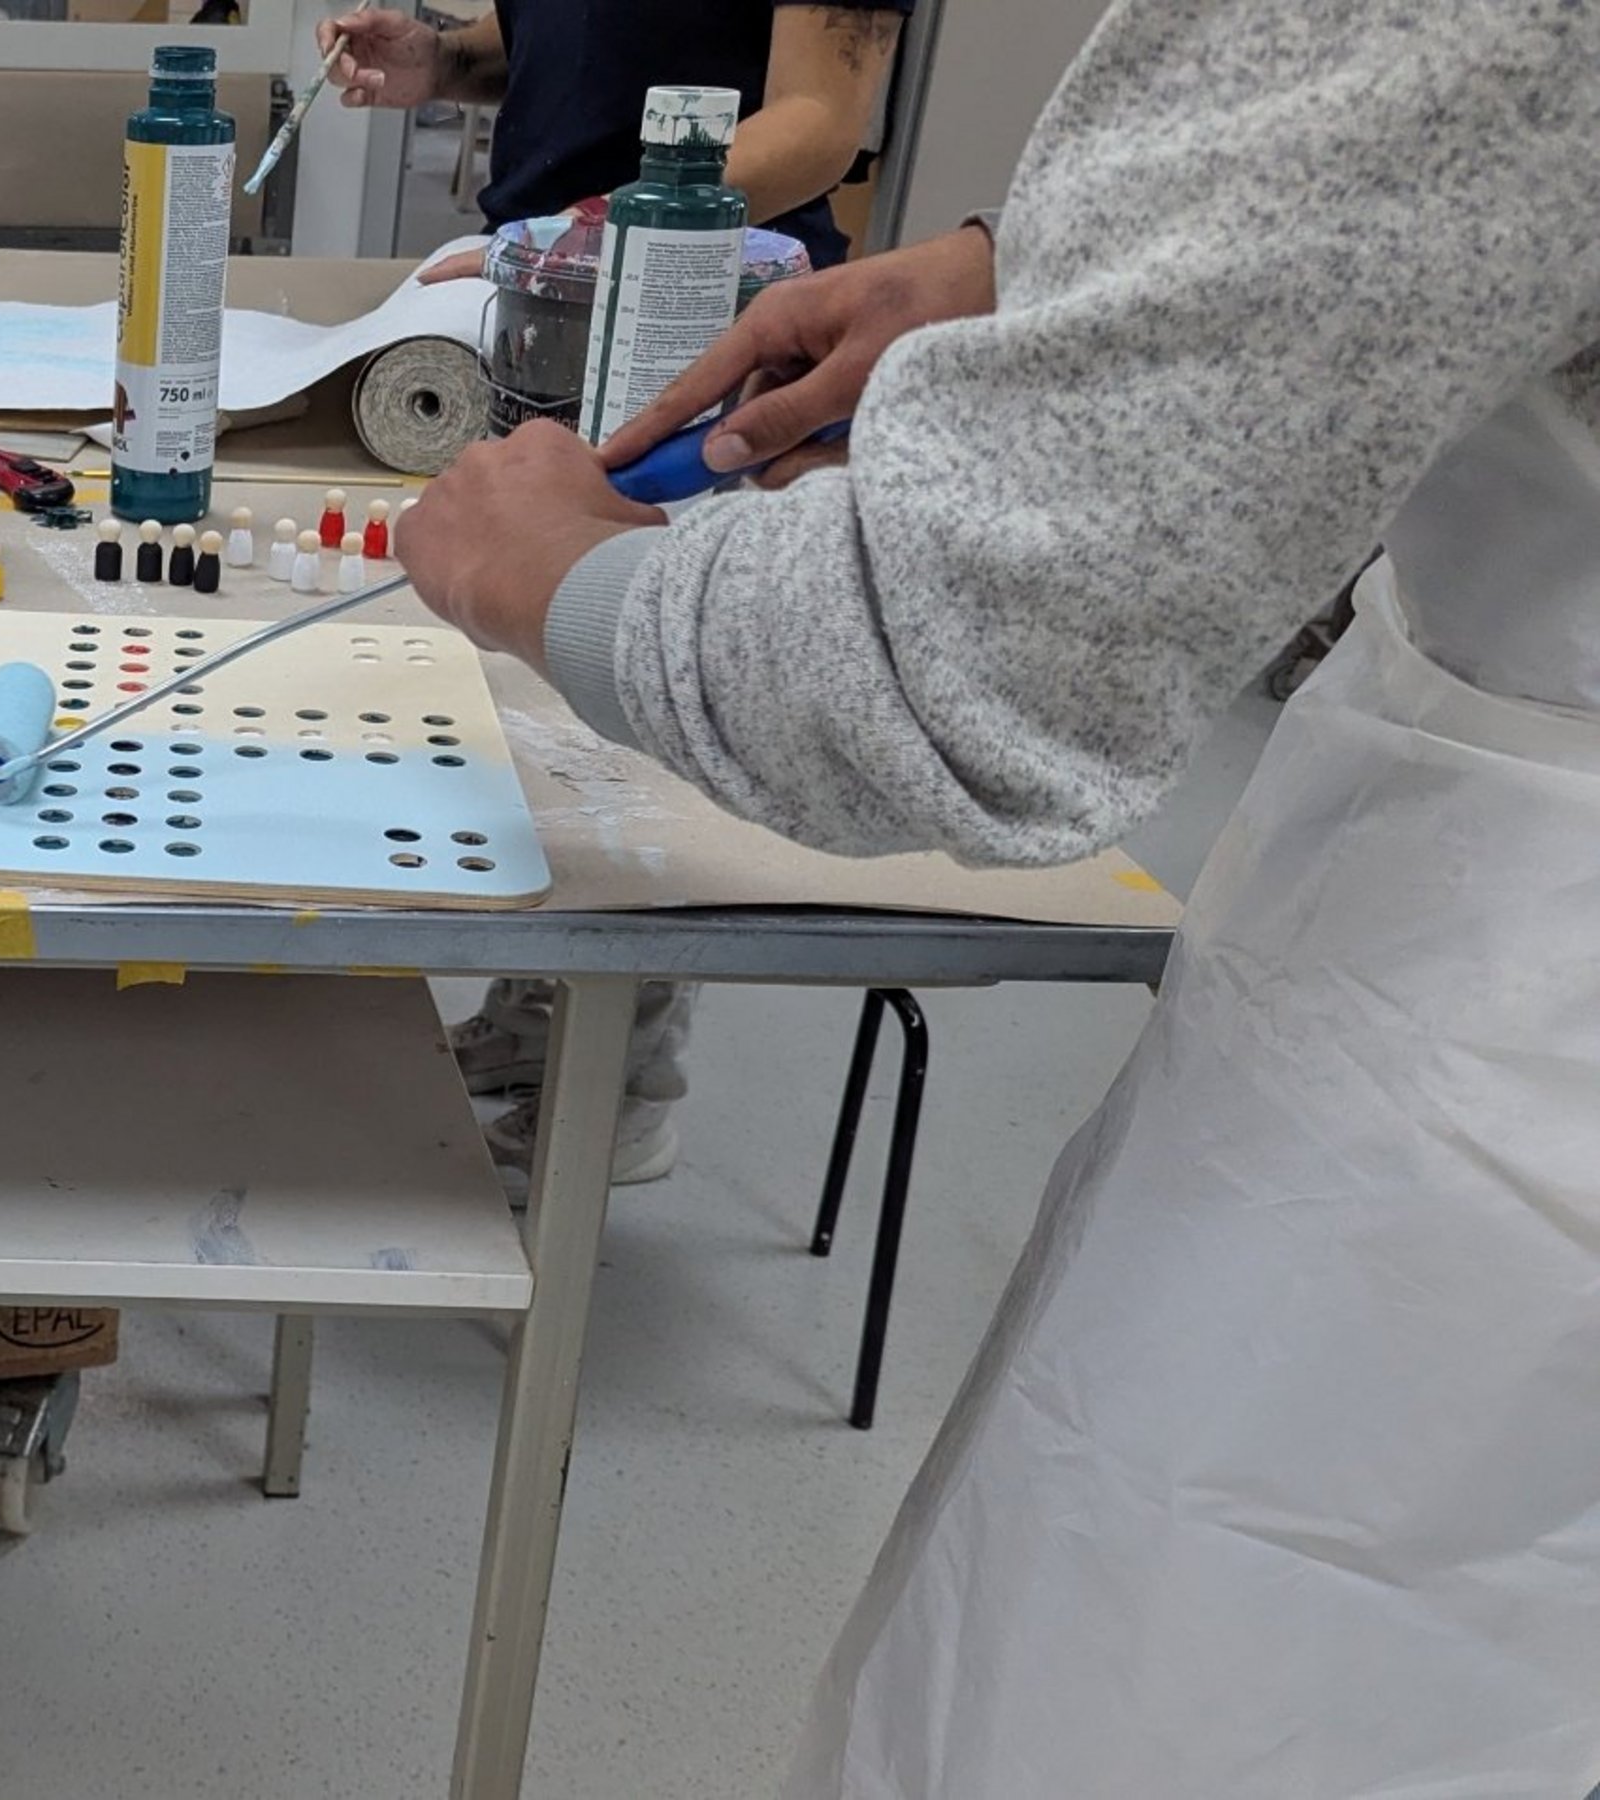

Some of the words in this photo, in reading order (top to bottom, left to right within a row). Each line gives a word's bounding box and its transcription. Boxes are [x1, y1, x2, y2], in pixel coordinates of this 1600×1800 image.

[159, 387, 189, 402] 750
[192, 388, 206, 400] ml
[13, 1307, 93, 1335] EPAL
